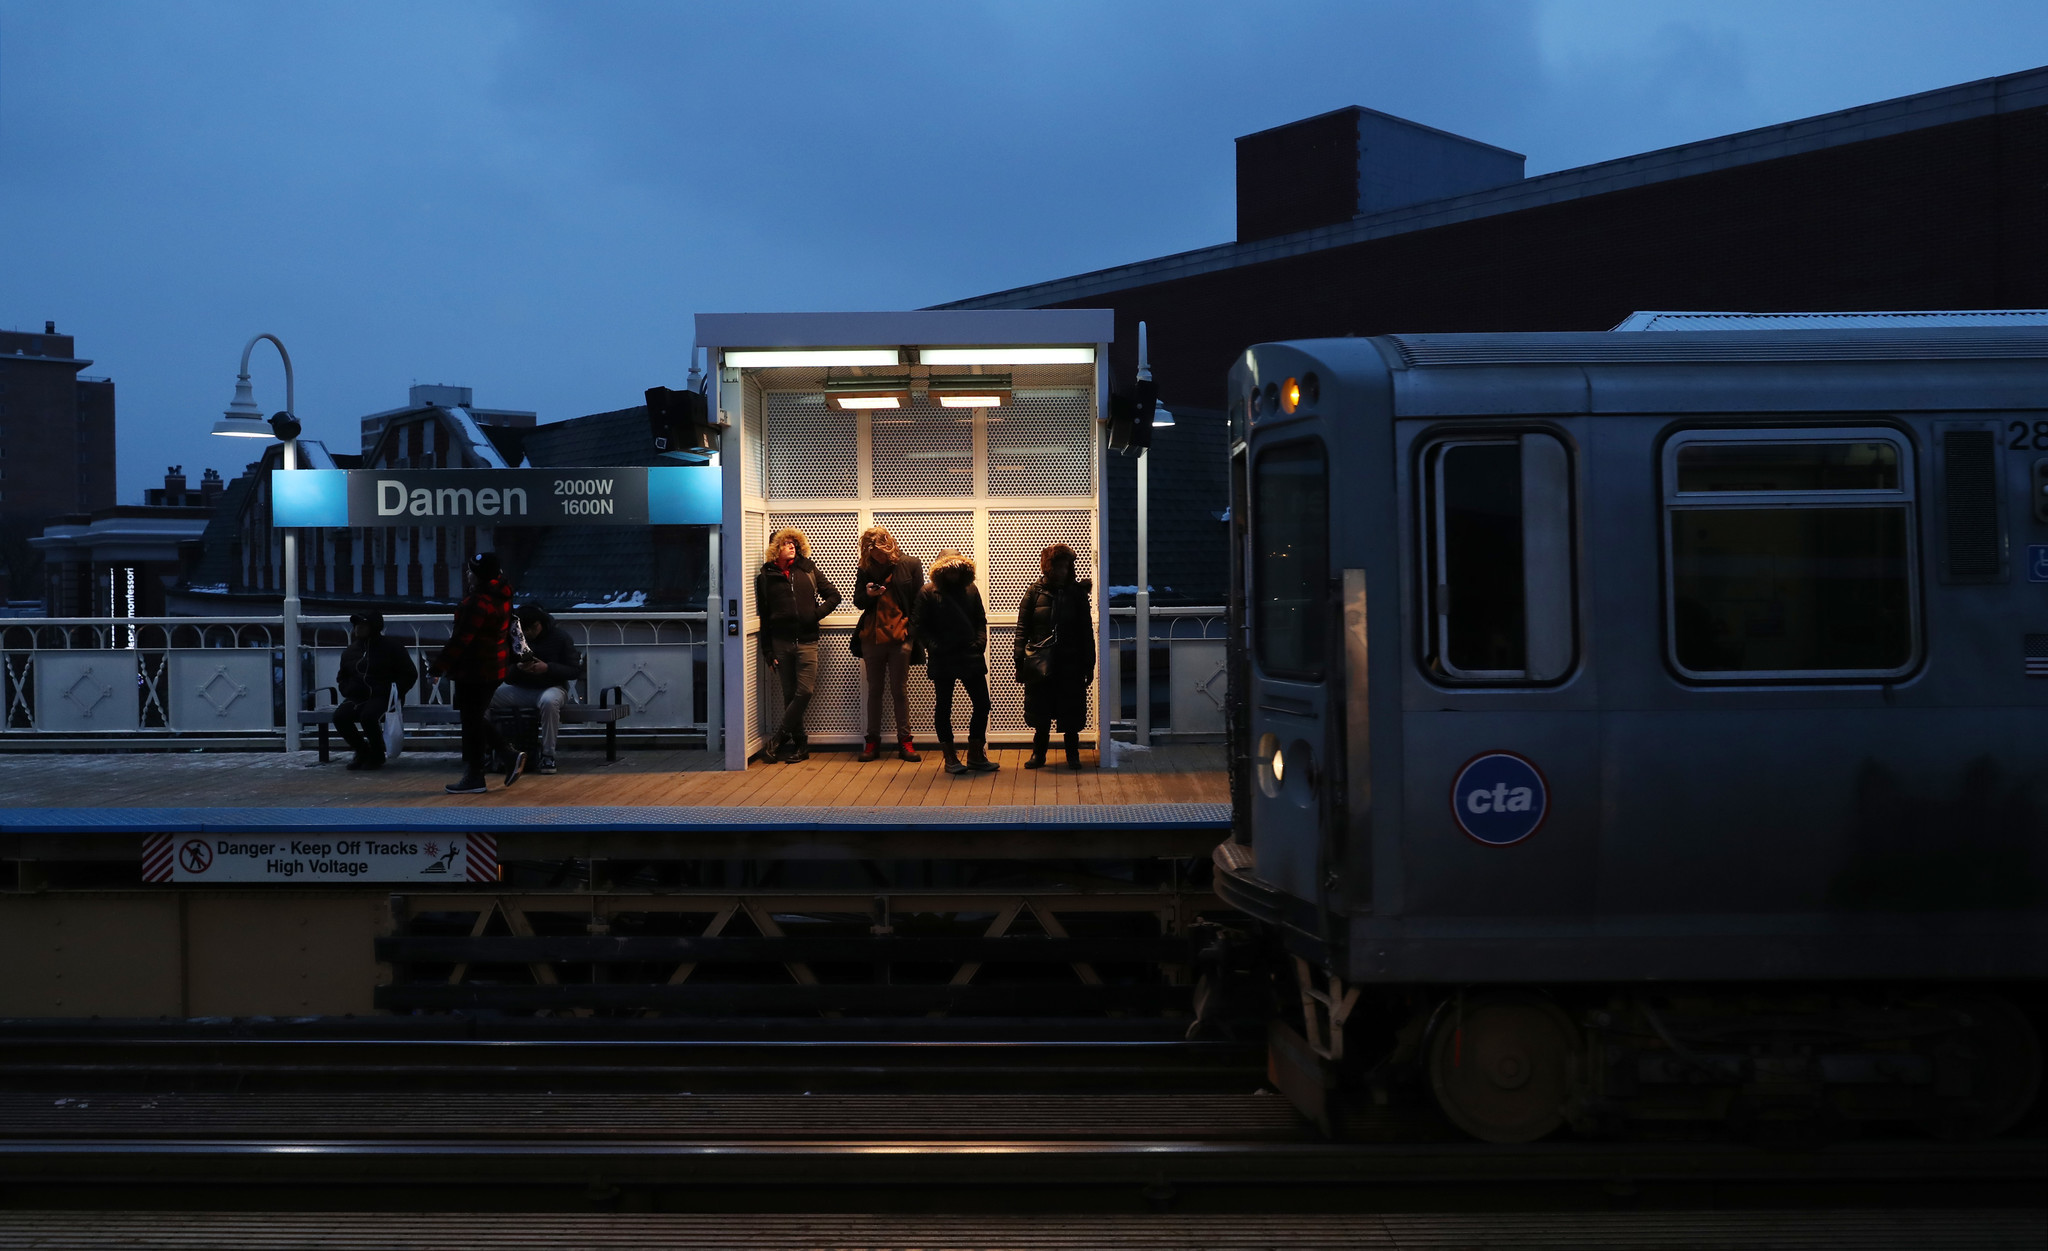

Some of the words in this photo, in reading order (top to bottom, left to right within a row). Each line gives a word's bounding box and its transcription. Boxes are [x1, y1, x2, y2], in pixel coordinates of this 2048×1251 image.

[554, 479, 614, 496] 2000W
[377, 479, 528, 517] Damen
[561, 499, 614, 515] 1600N
[124, 567, 135, 618] montessori
[1467, 782, 1533, 814] cta
[217, 841, 275, 858] Danger
[291, 841, 331, 858] Keep
[337, 841, 361, 855] Off
[365, 841, 418, 855] Tracks
[267, 859, 304, 876] High
[309, 859, 368, 876] Voltage
